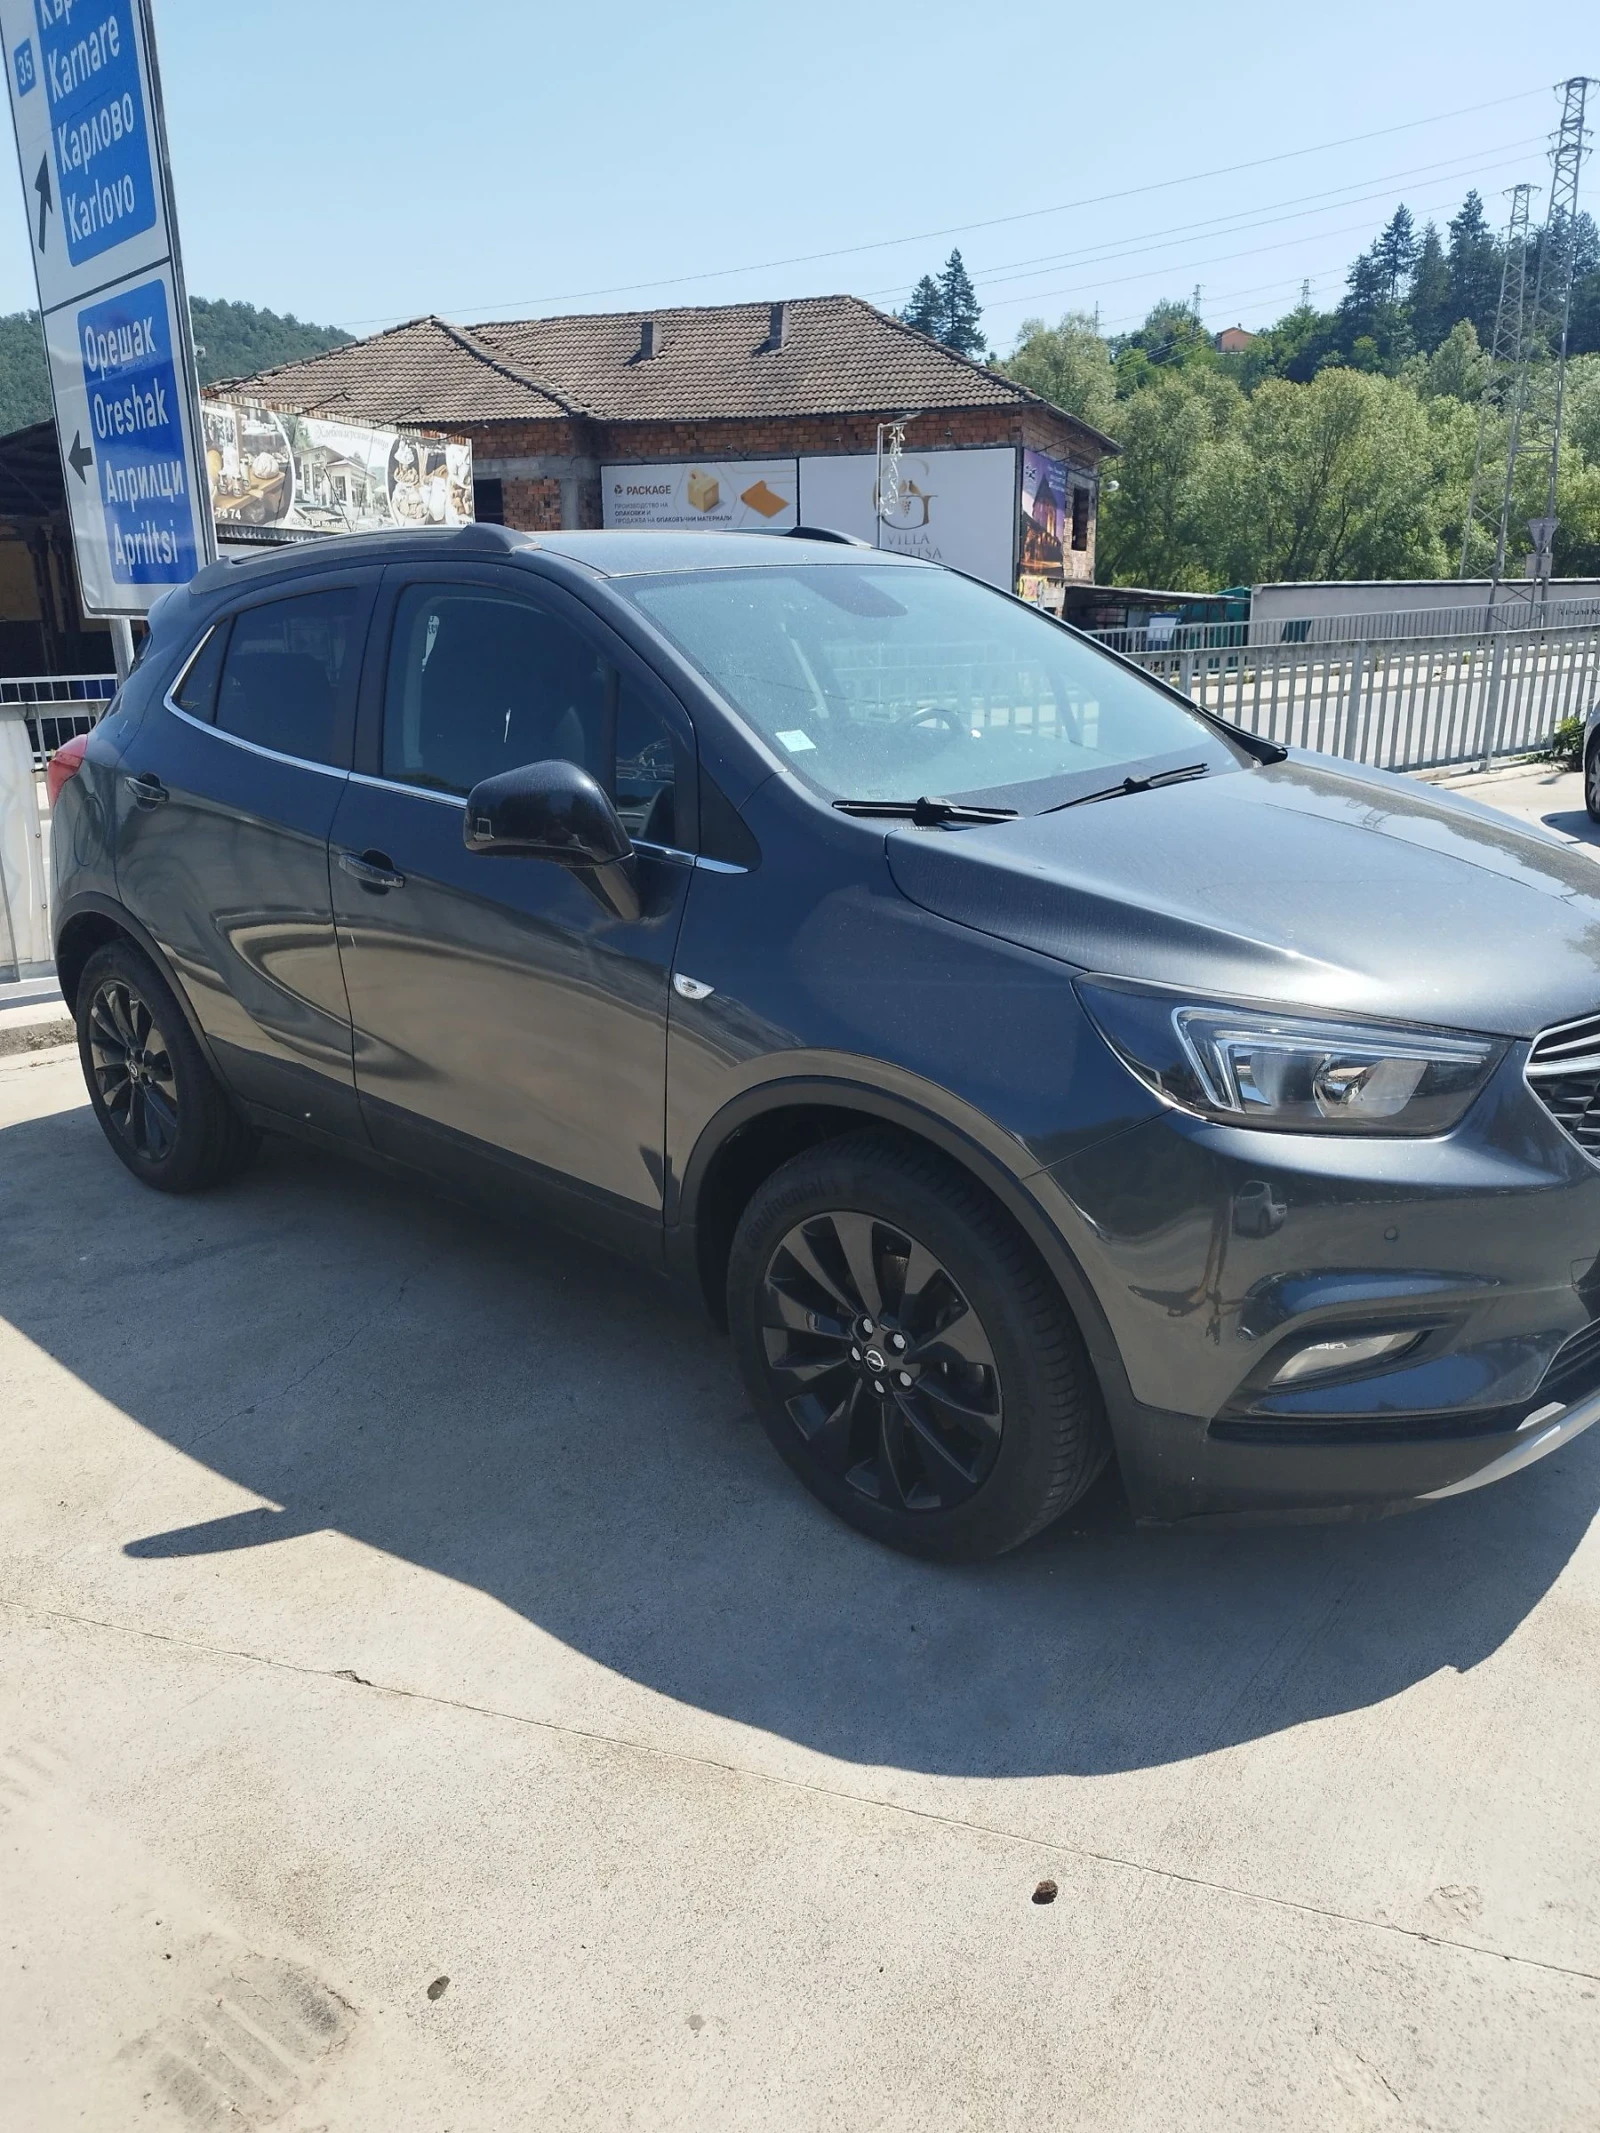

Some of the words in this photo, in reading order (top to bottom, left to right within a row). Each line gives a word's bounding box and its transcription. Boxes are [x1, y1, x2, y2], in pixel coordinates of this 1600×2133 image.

[18, 50, 33, 86] 35
[48, 15, 121, 103] Karnare
[58, 92, 134, 175] Карлово
[67, 174, 135, 244] Karlovo
[84, 316, 157, 380] Орешак
[93, 378, 170, 439] Oreshak
[105, 460, 185, 512] Априлци
[229, 508, 242, 520] 74
[626, 484, 672, 495] PACKAGE
[113, 520, 179, 576] Apriltsi
[888, 532, 930, 545] VILLA
